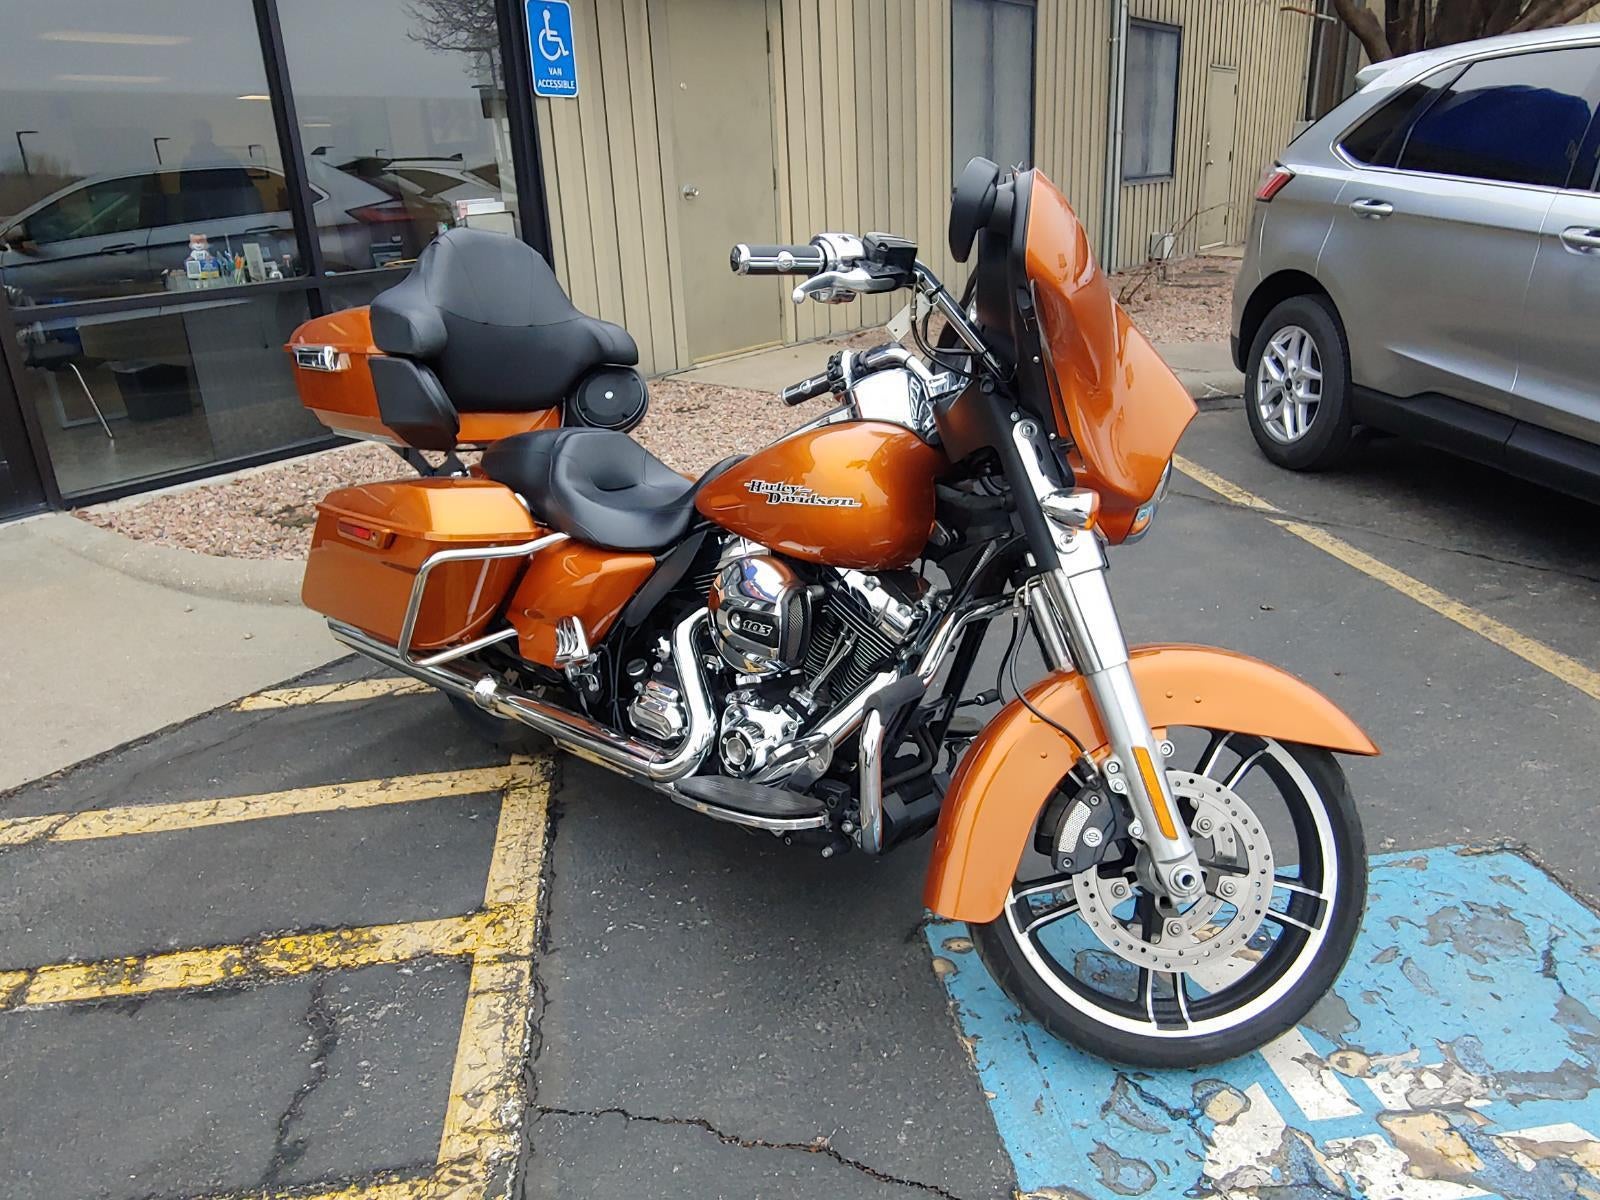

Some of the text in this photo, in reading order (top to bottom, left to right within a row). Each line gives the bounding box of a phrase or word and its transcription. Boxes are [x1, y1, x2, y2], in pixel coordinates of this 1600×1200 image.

[548, 66, 563, 76] VAN
[537, 79, 575, 89] ACCESSIBLE
[767, 492, 862, 508] Davidson
[743, 619, 773, 637] 103
